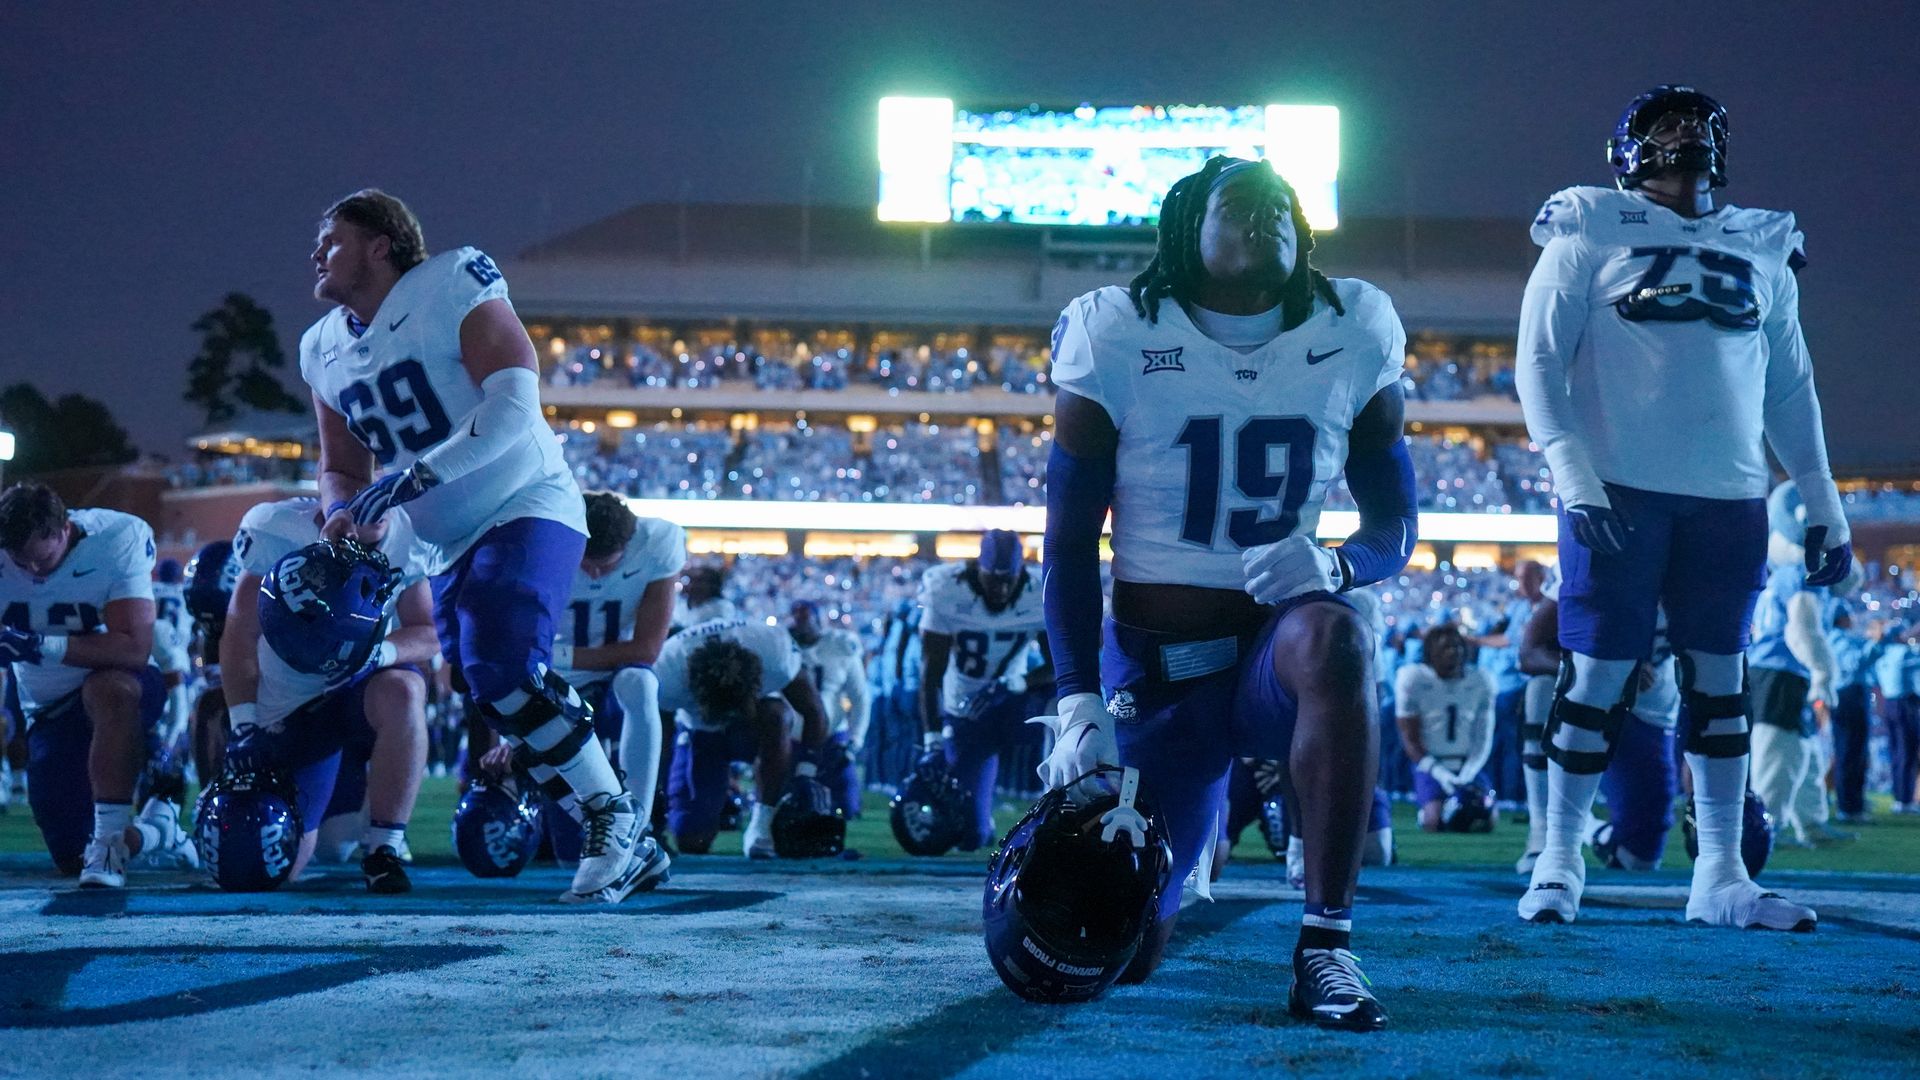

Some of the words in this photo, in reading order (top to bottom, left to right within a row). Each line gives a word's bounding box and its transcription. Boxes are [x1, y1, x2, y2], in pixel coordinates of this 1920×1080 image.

[1141, 346, 1186, 376] XII
[1235, 369, 1258, 380] TCU
[338, 358, 453, 466] 69
[1170, 413, 1319, 550] 19
[278, 555, 318, 613] TCU
[566, 599, 622, 648] 11
[956, 629, 1029, 679] 87
[260, 823, 290, 878] TCU
[483, 820, 519, 868] TCU
[1022, 935, 1056, 968] FROGS
[1056, 962, 1105, 976] HORNED
